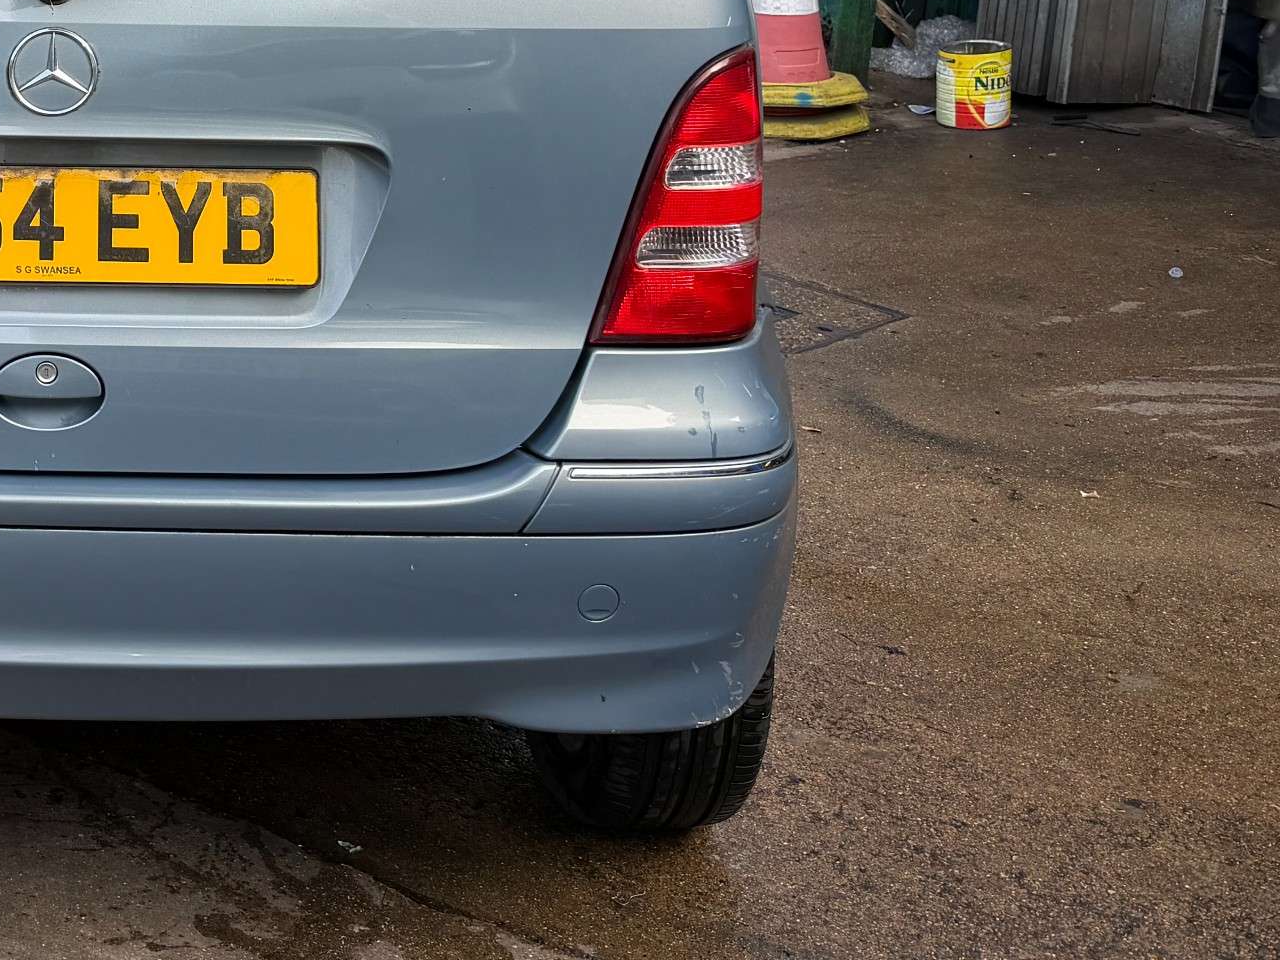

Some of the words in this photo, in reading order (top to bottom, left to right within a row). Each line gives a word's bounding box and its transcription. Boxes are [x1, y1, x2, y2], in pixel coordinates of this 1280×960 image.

[97, 179, 275, 265] EYB
[15, 265, 22, 274] S
[24, 265, 32, 274] G
[34, 265, 82, 275] SWANSEA
